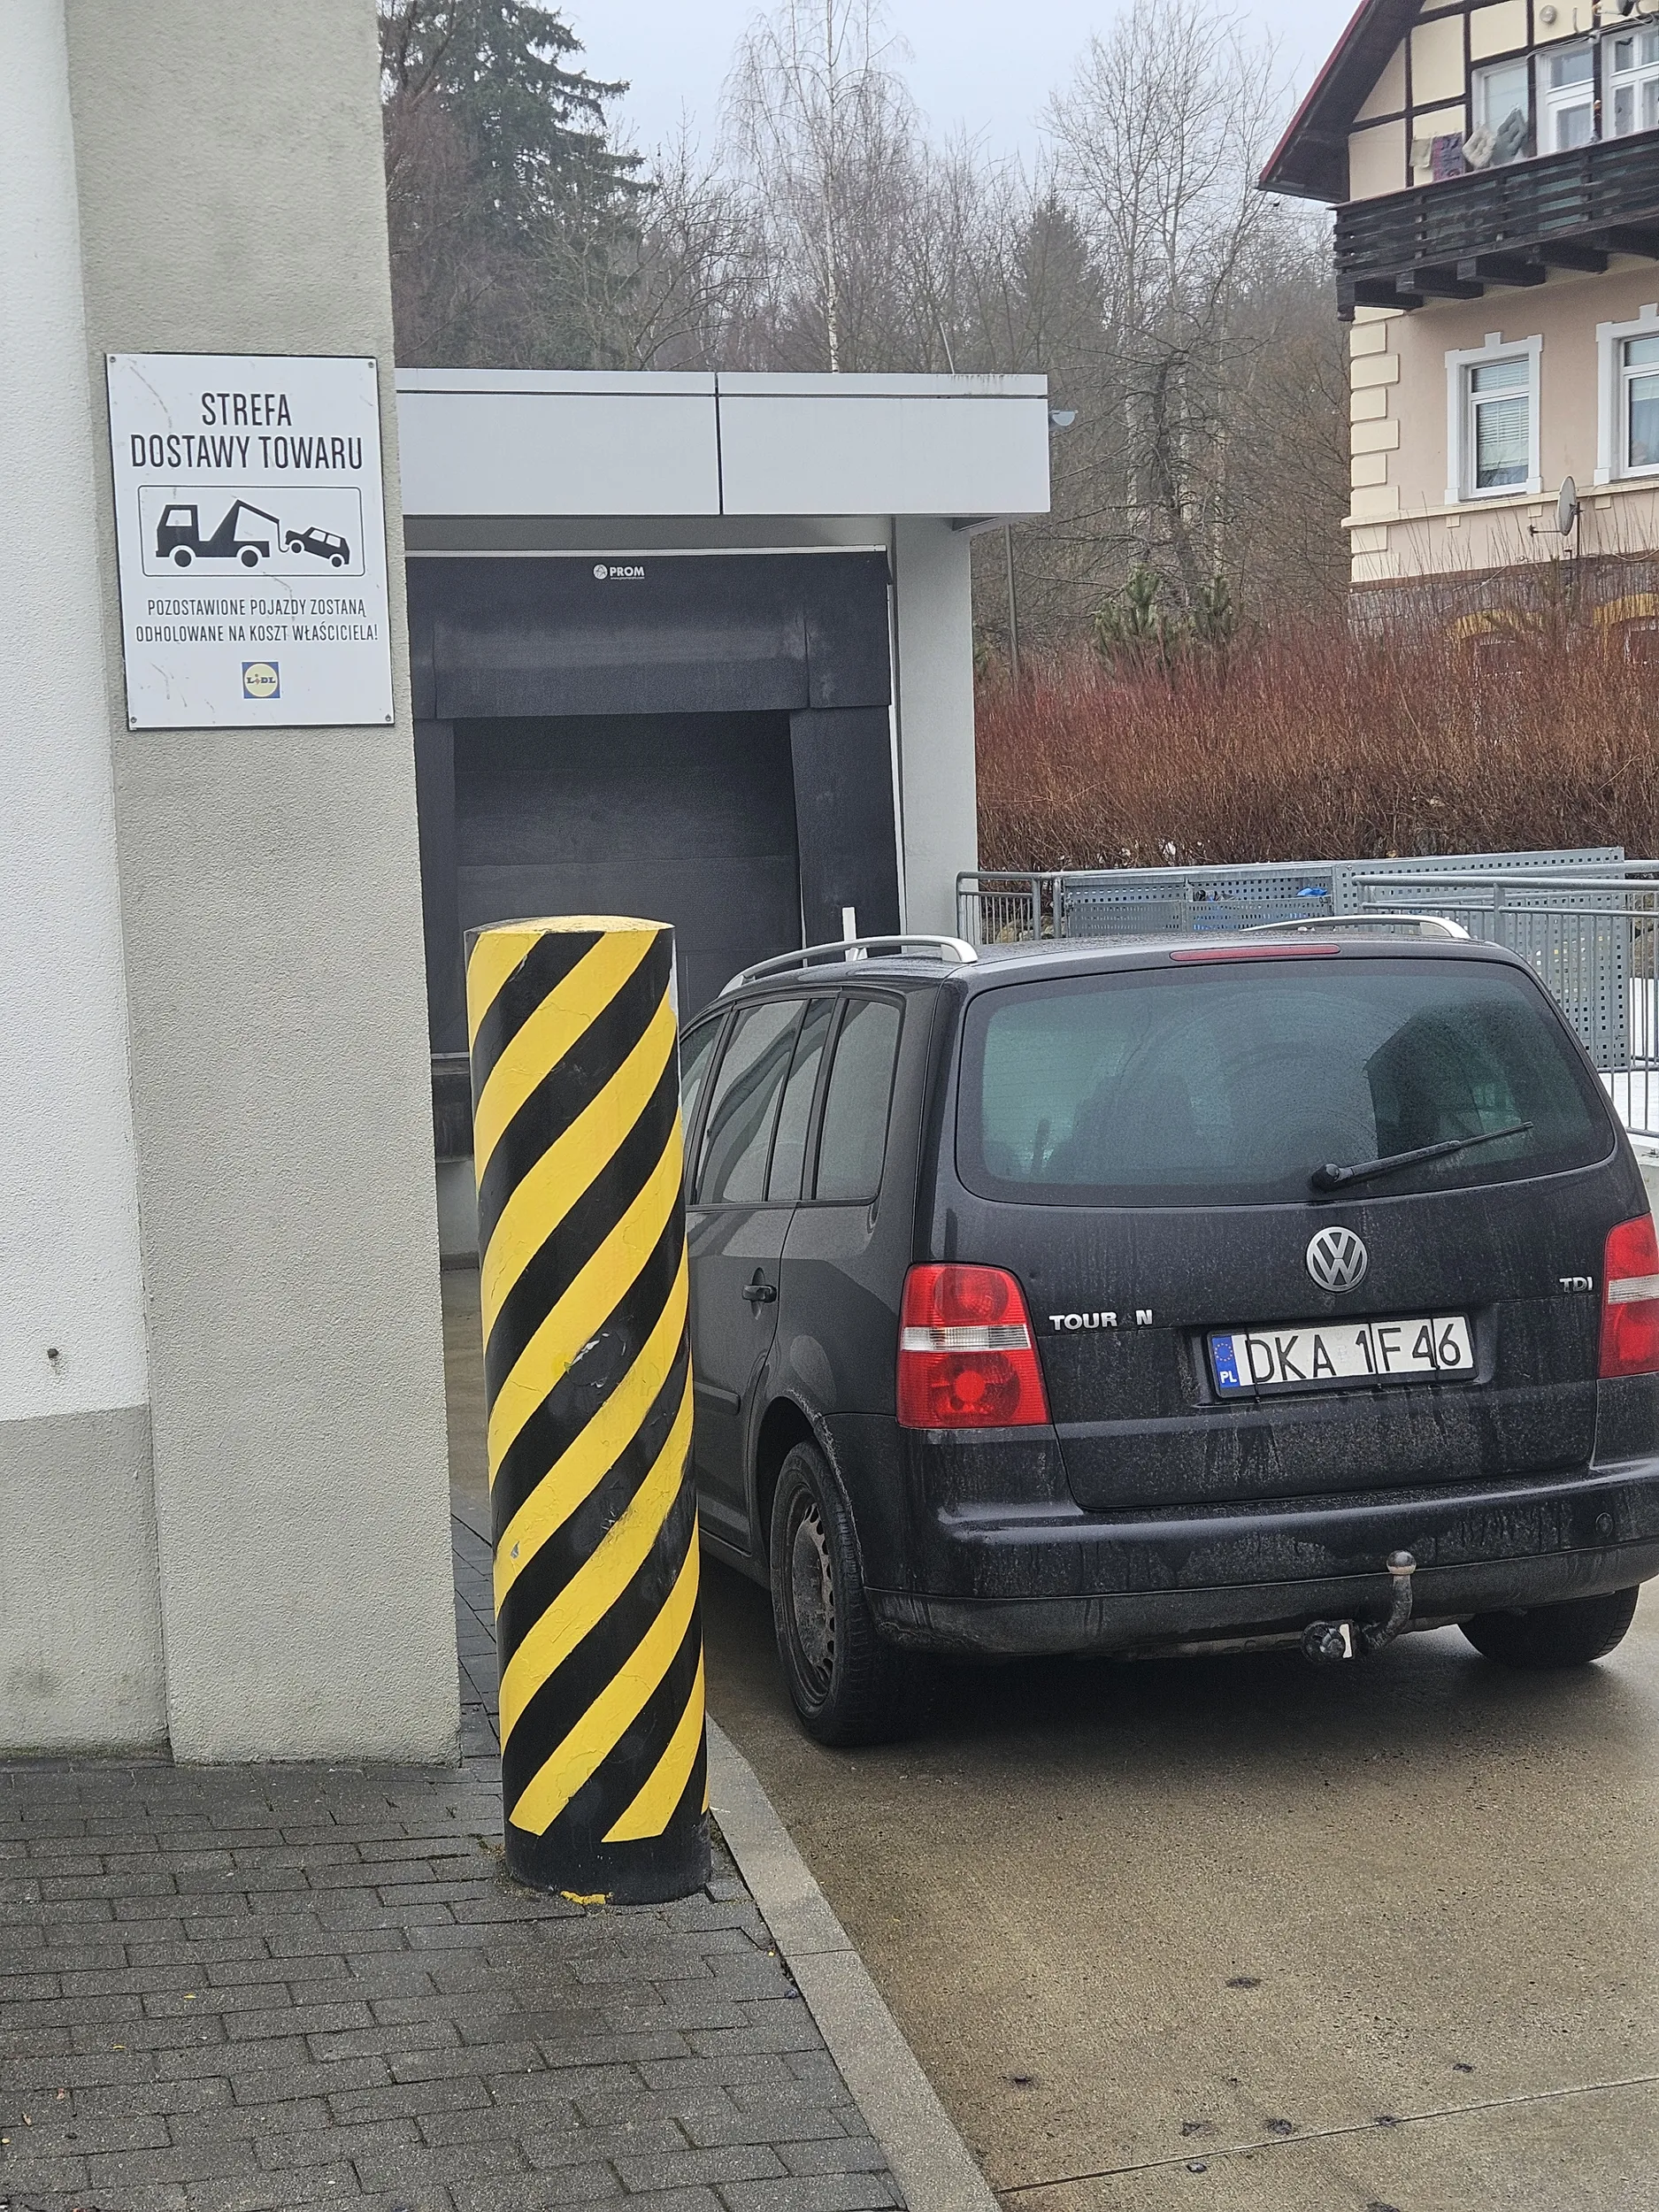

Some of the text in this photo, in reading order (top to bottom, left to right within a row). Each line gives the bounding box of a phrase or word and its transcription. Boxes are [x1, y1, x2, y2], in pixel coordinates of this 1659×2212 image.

[201, 392, 292, 426] STREFA
[130, 434, 363, 470] DOSTAWY TOWARU
[610, 566, 645, 577] PROM
[147, 599, 367, 618] POZOSTAWIONE POJAZDY ZOSTANĄ
[135, 620, 378, 642] ODHOLOWANE NA KOSZT WŁAŚCICIELA!
[1559, 1276, 1594, 1293] TDI
[1245, 1334, 1337, 1383] DKA
[1219, 1370, 1238, 1384] PL
